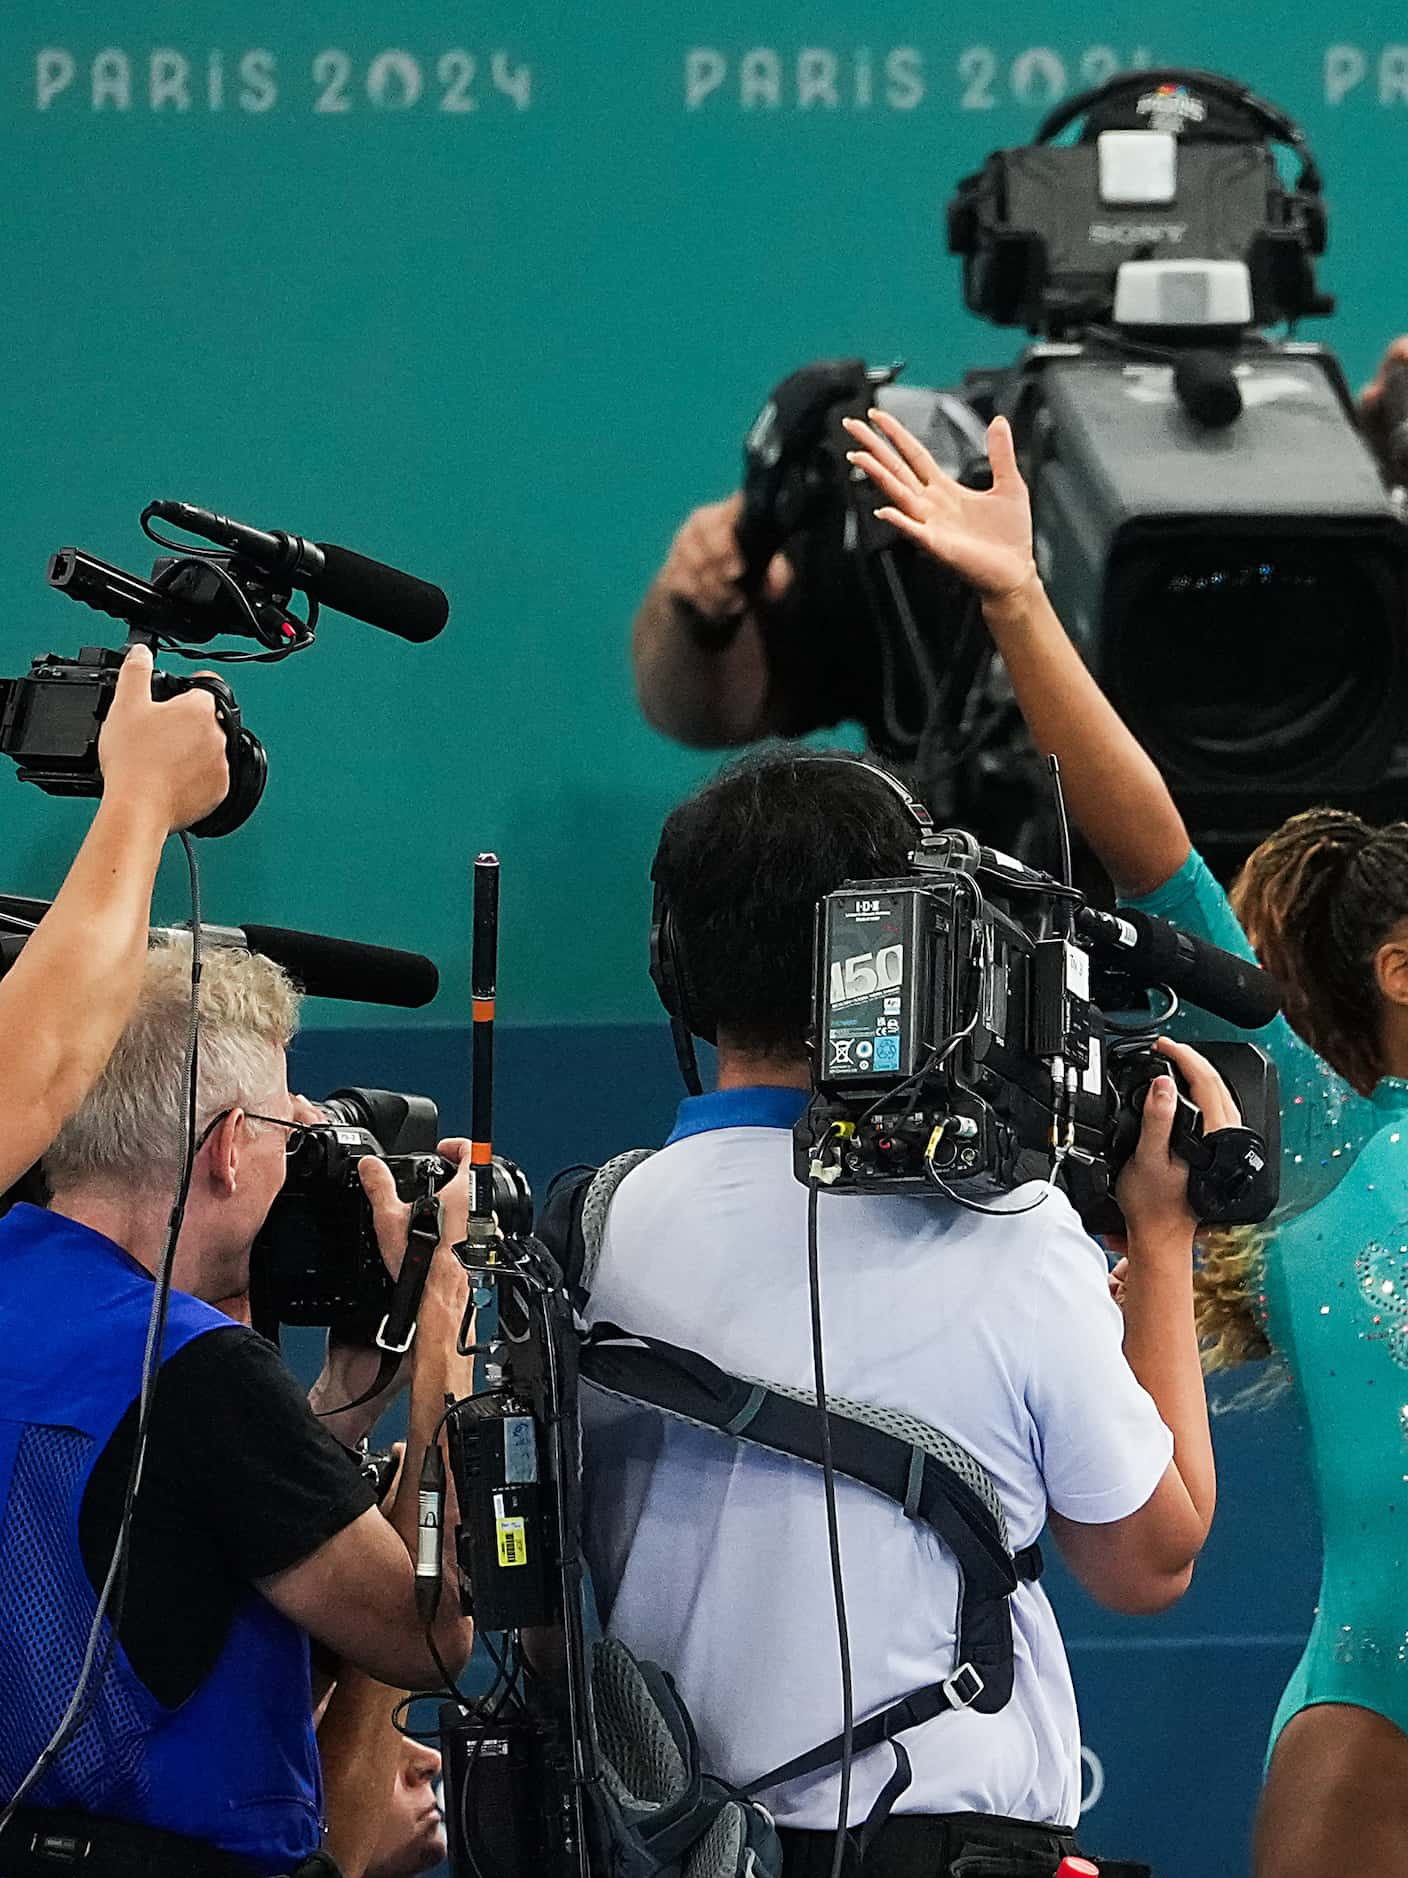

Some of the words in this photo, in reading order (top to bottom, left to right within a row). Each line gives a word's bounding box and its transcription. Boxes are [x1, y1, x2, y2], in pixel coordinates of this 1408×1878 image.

[35, 48, 278, 113] PARIS
[313, 48, 532, 114] 2024
[685, 47, 926, 111] PARIS
[1088, 221, 1189, 245] SONY
[830, 944, 903, 1004] 150
